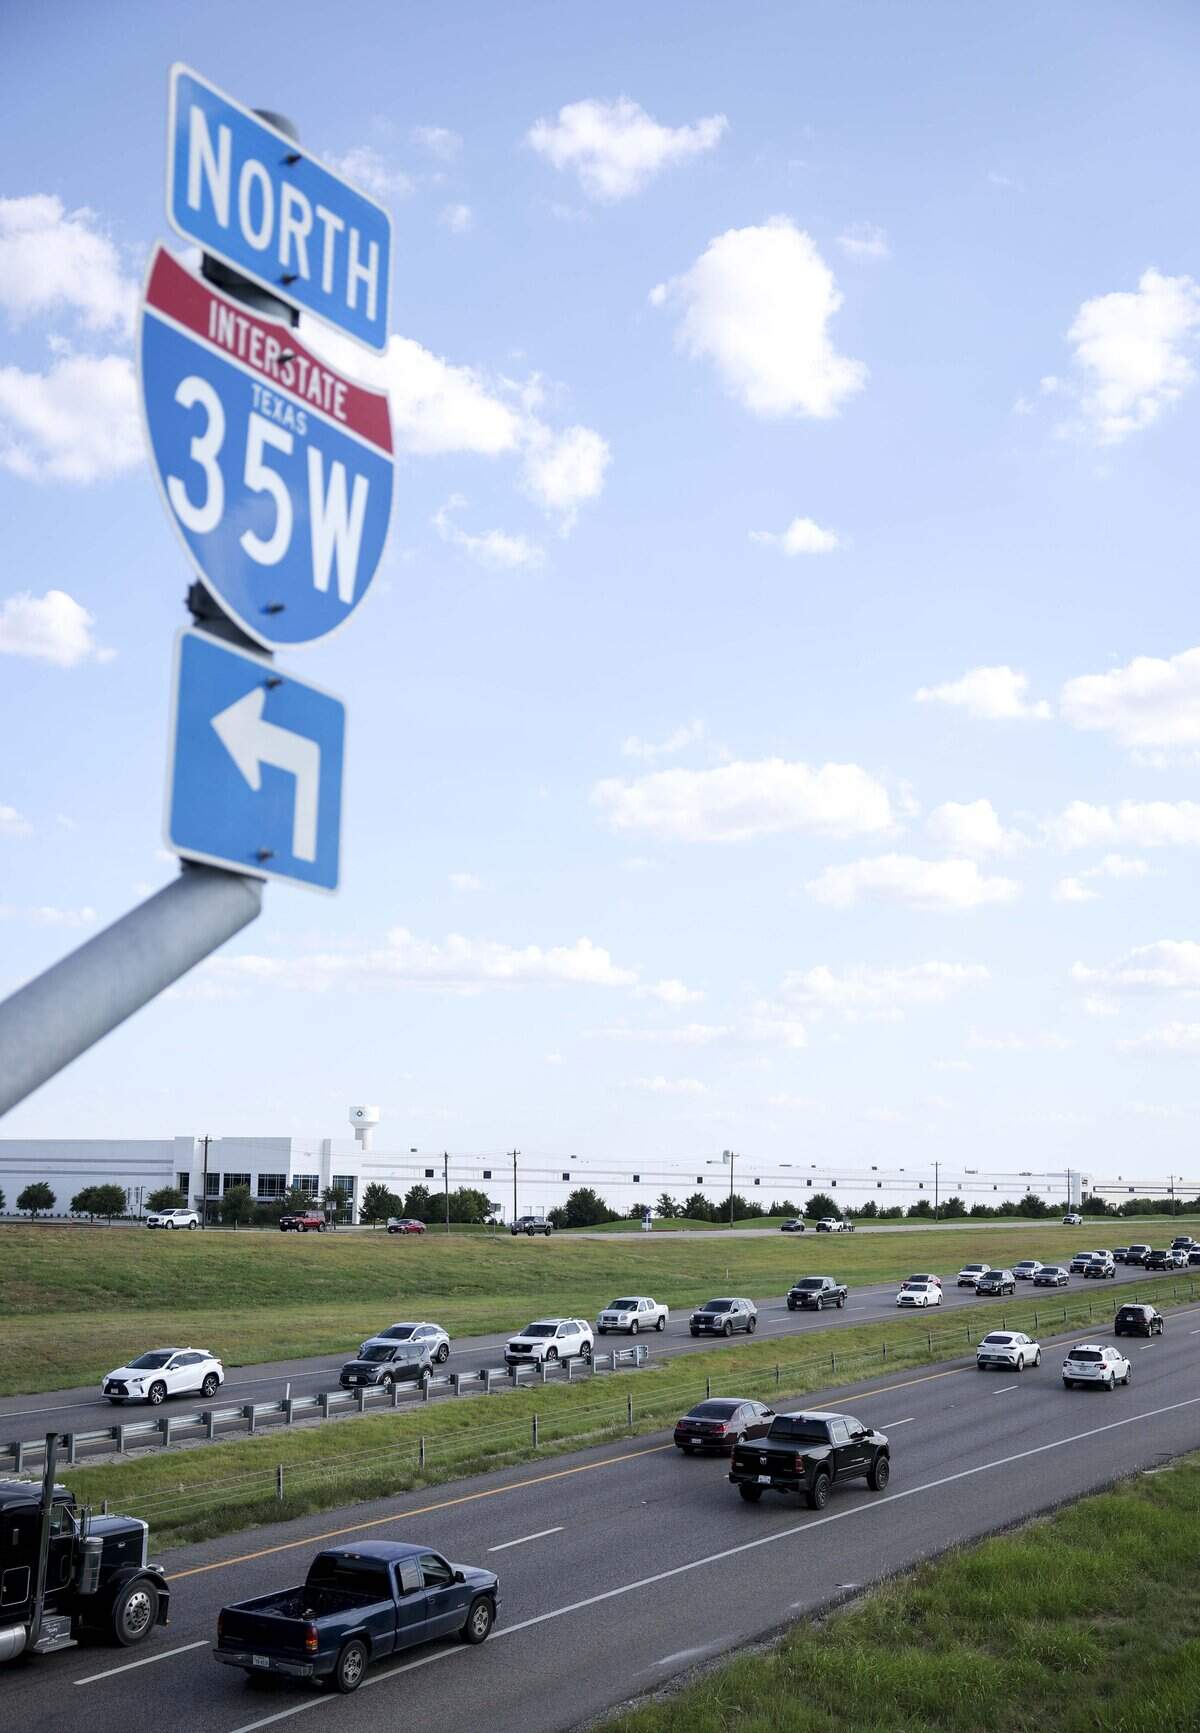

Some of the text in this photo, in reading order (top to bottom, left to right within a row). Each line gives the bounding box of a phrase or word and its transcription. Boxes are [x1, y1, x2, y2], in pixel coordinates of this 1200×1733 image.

[187, 104, 379, 323] NORTH
[208, 300, 348, 422] INTERSTATE
[252, 383, 307, 437] TEXAS
[166, 375, 369, 605] 35W
